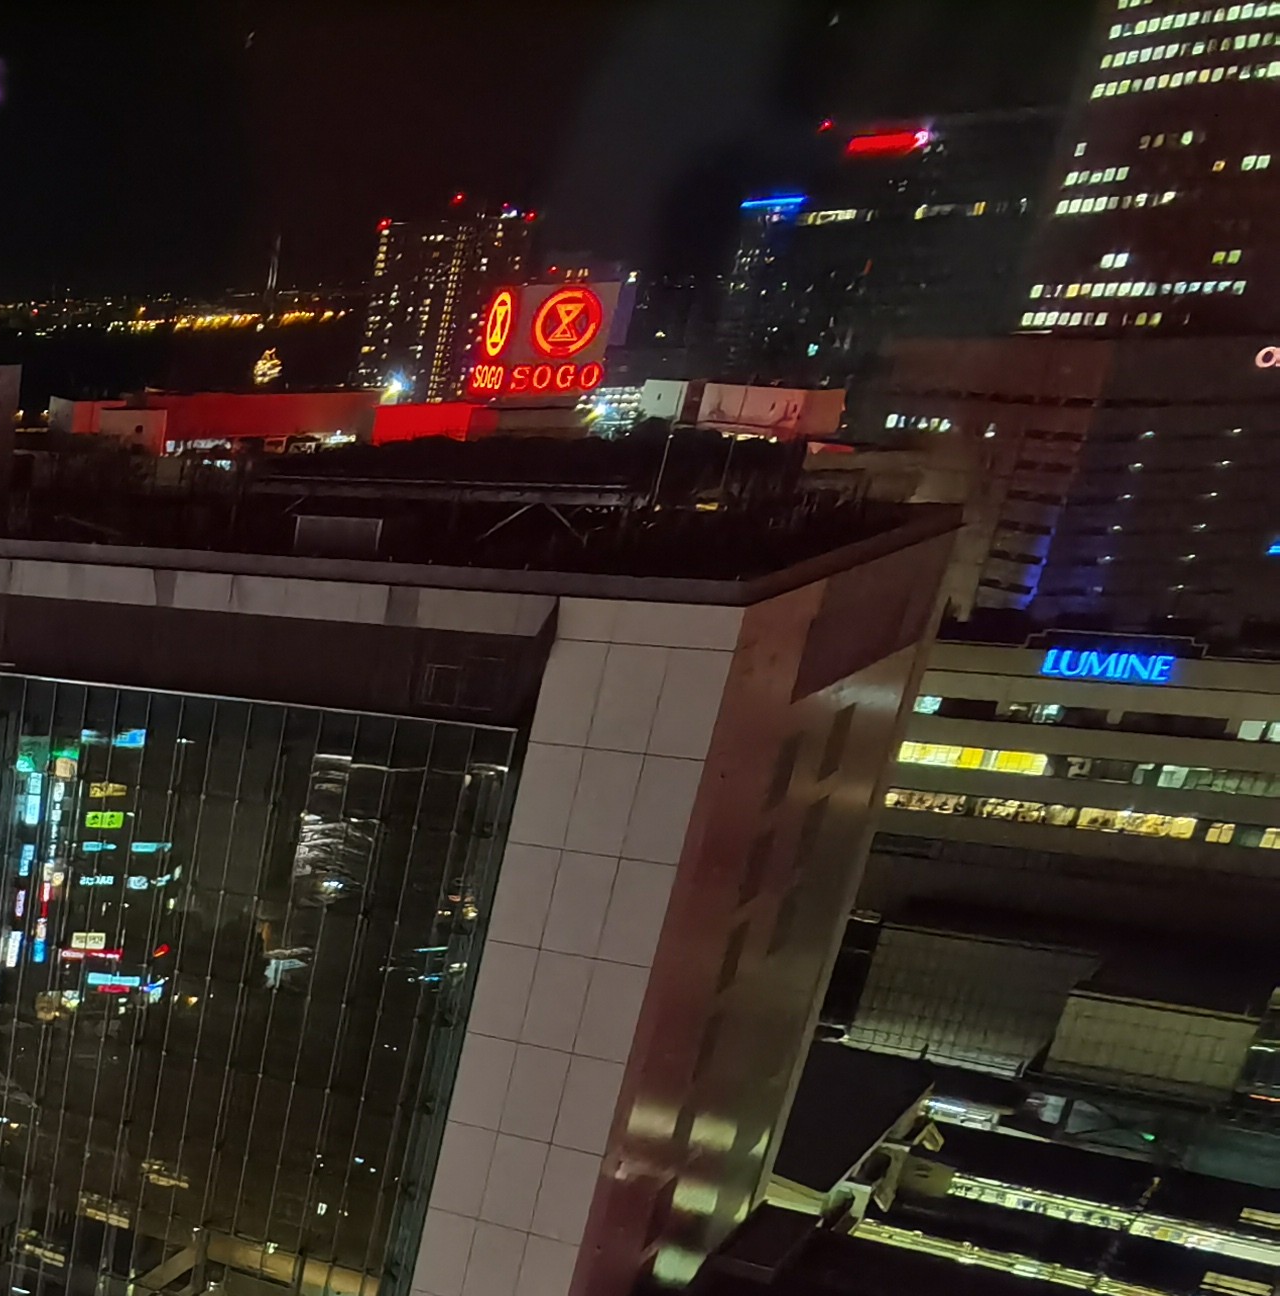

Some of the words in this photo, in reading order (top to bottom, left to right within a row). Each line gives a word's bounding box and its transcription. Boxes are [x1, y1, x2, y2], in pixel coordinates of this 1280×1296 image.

[473, 365, 503, 389] SOGO
[510, 365, 599, 389] SOGO
[1042, 649, 1174, 681] LUMINE
